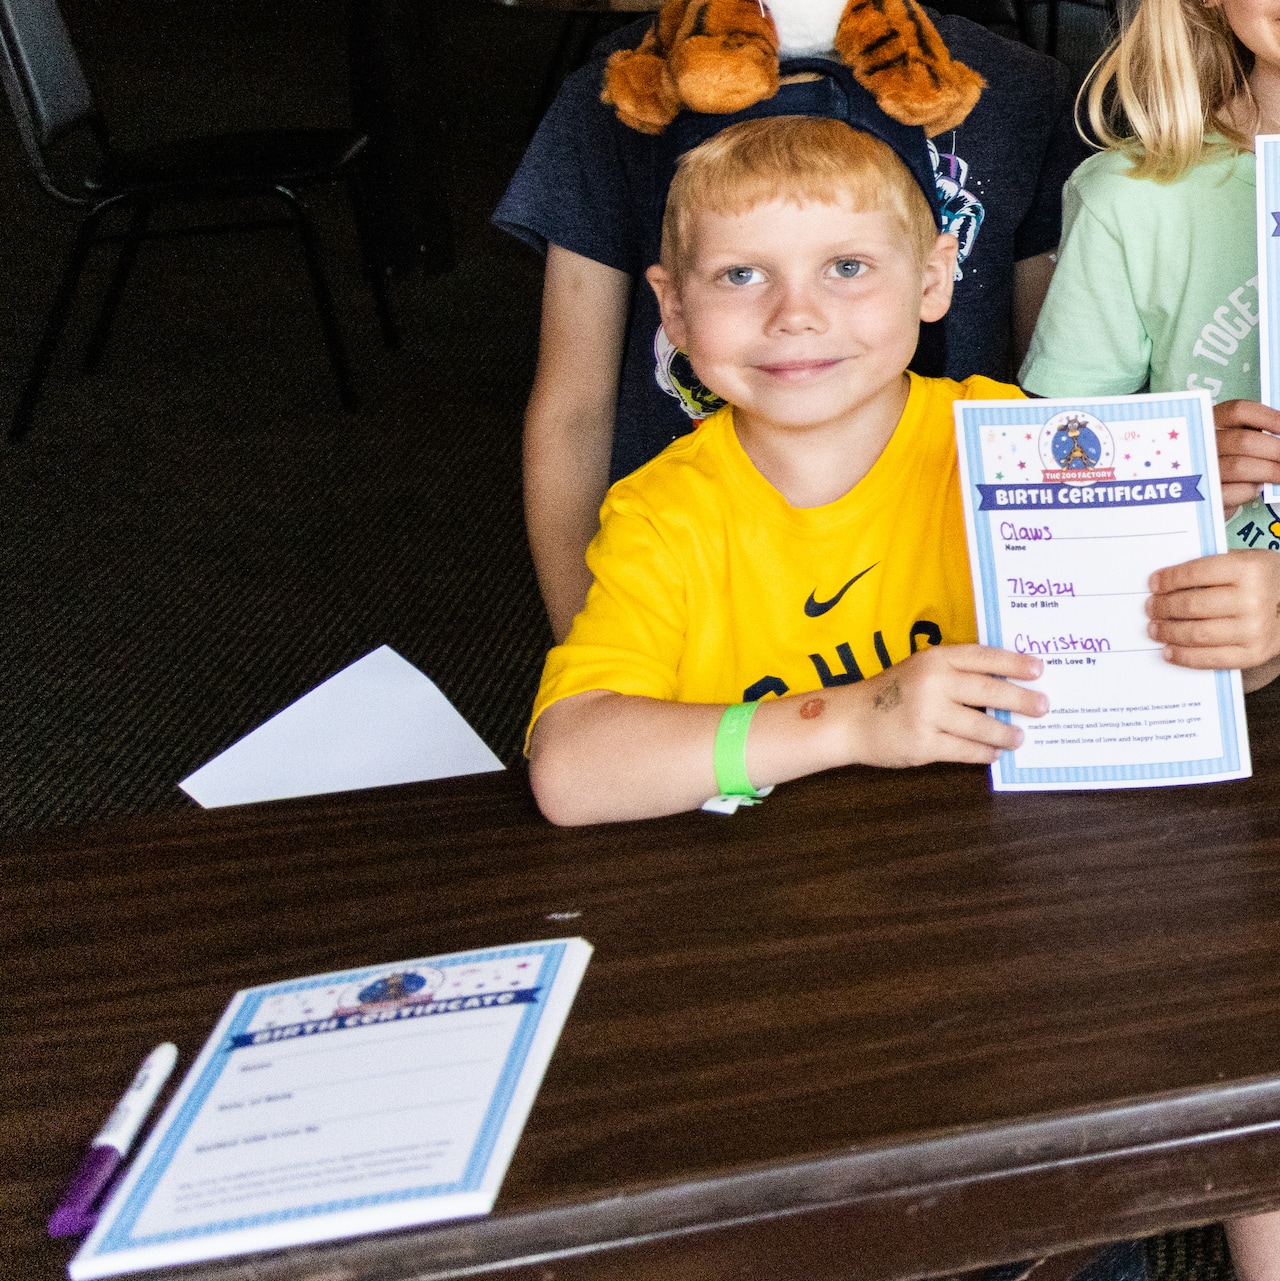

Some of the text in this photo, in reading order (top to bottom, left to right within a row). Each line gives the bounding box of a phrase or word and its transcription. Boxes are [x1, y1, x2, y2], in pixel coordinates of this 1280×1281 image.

[995, 489, 1053, 506] BIRTH
[1000, 522, 1052, 541] Claws
[1237, 521, 1264, 547] AT
[1007, 578, 1076, 597] 7/30/24
[1014, 634, 1111, 654] Christian
